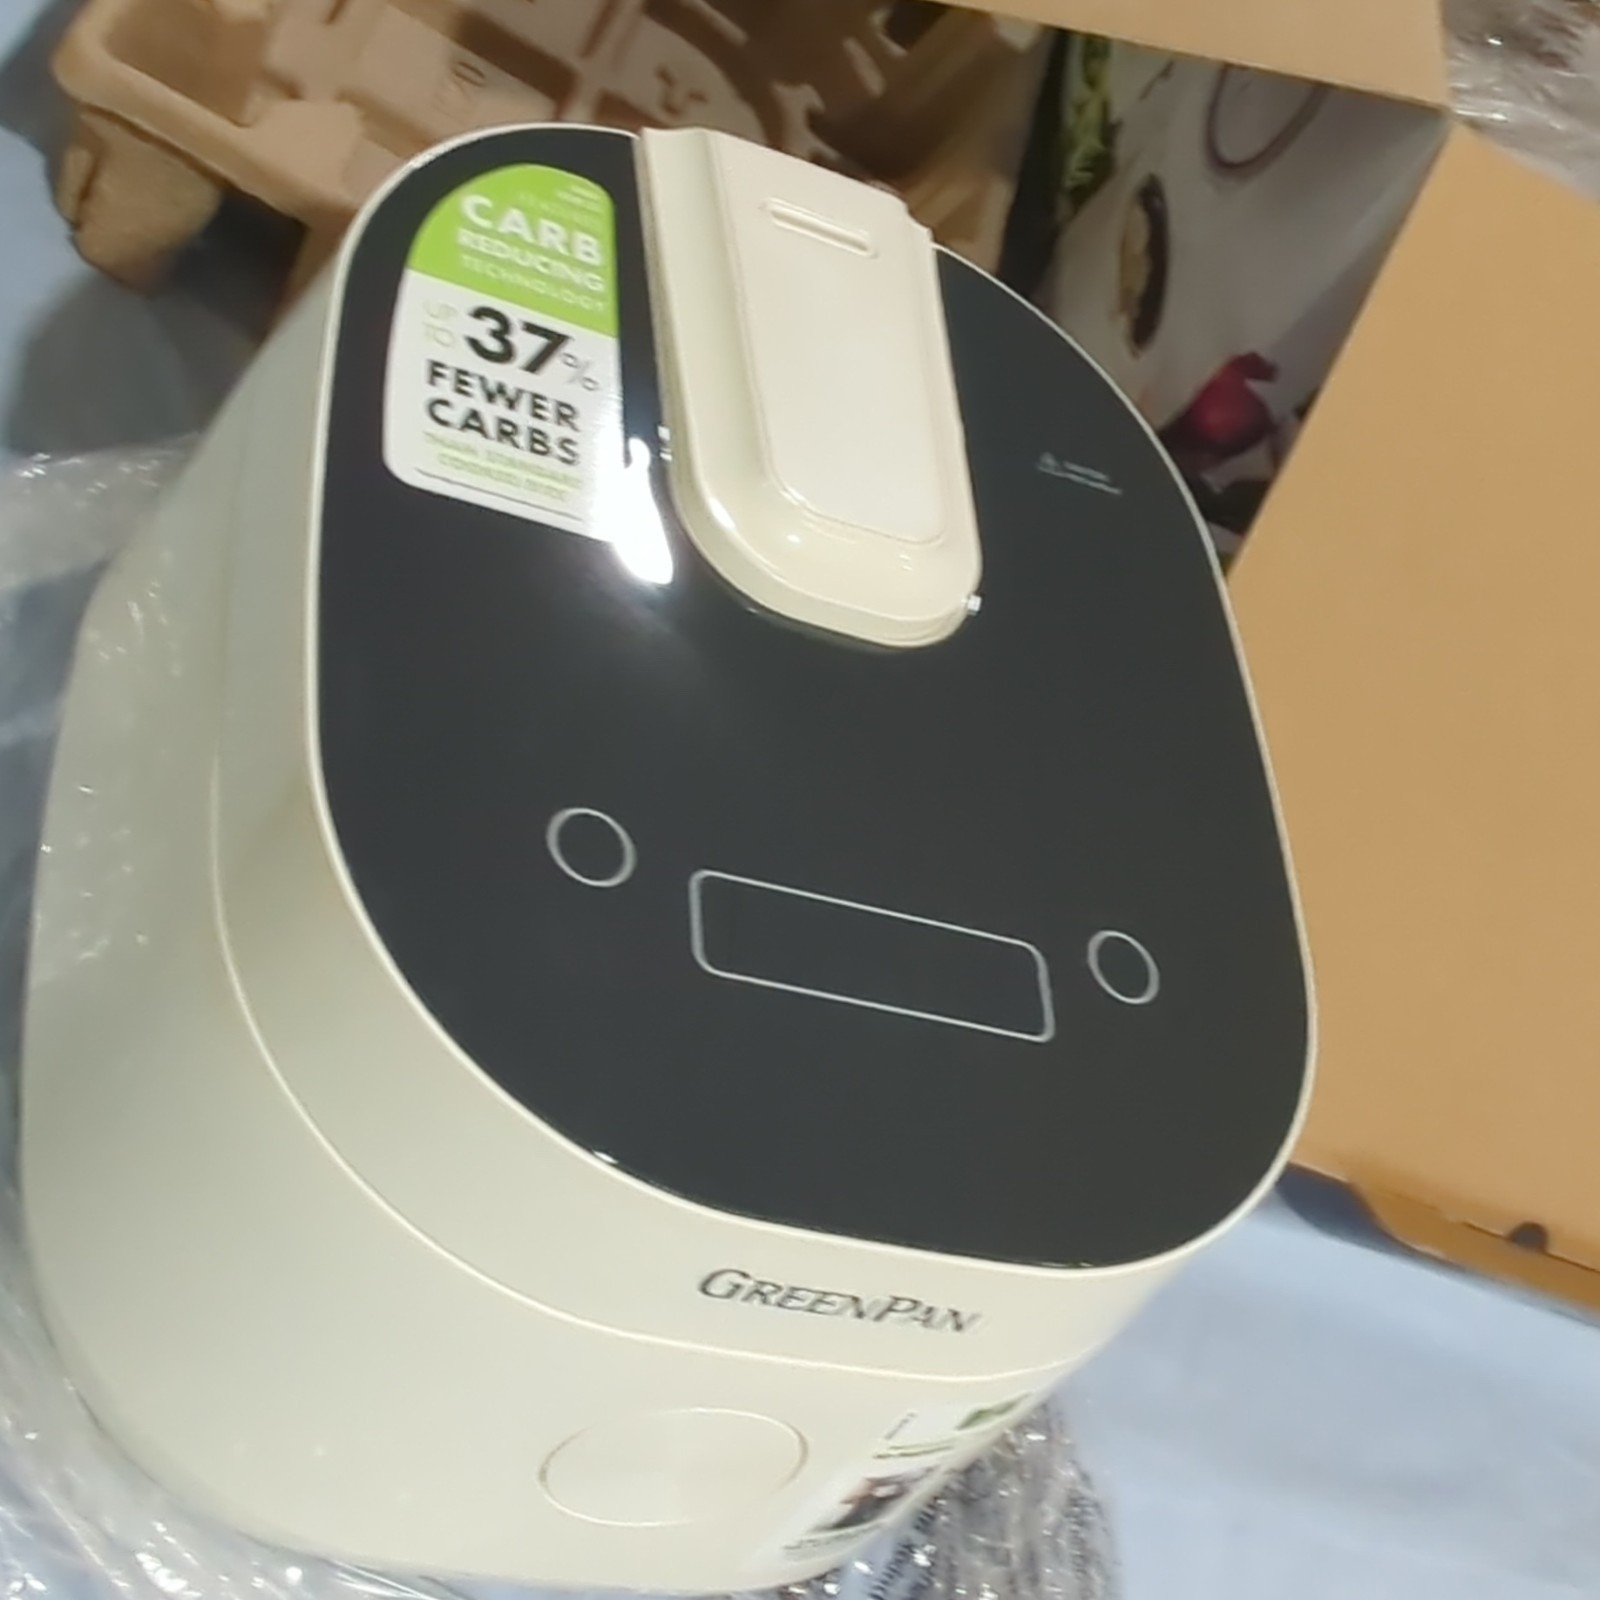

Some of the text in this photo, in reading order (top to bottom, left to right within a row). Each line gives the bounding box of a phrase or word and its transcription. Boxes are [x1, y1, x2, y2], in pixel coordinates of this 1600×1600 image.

[457, 227, 606, 292] REDUCING
[459, 193, 606, 267] CARB
[426, 358, 581, 432] FEWER
[426, 397, 581, 467] CARBS
